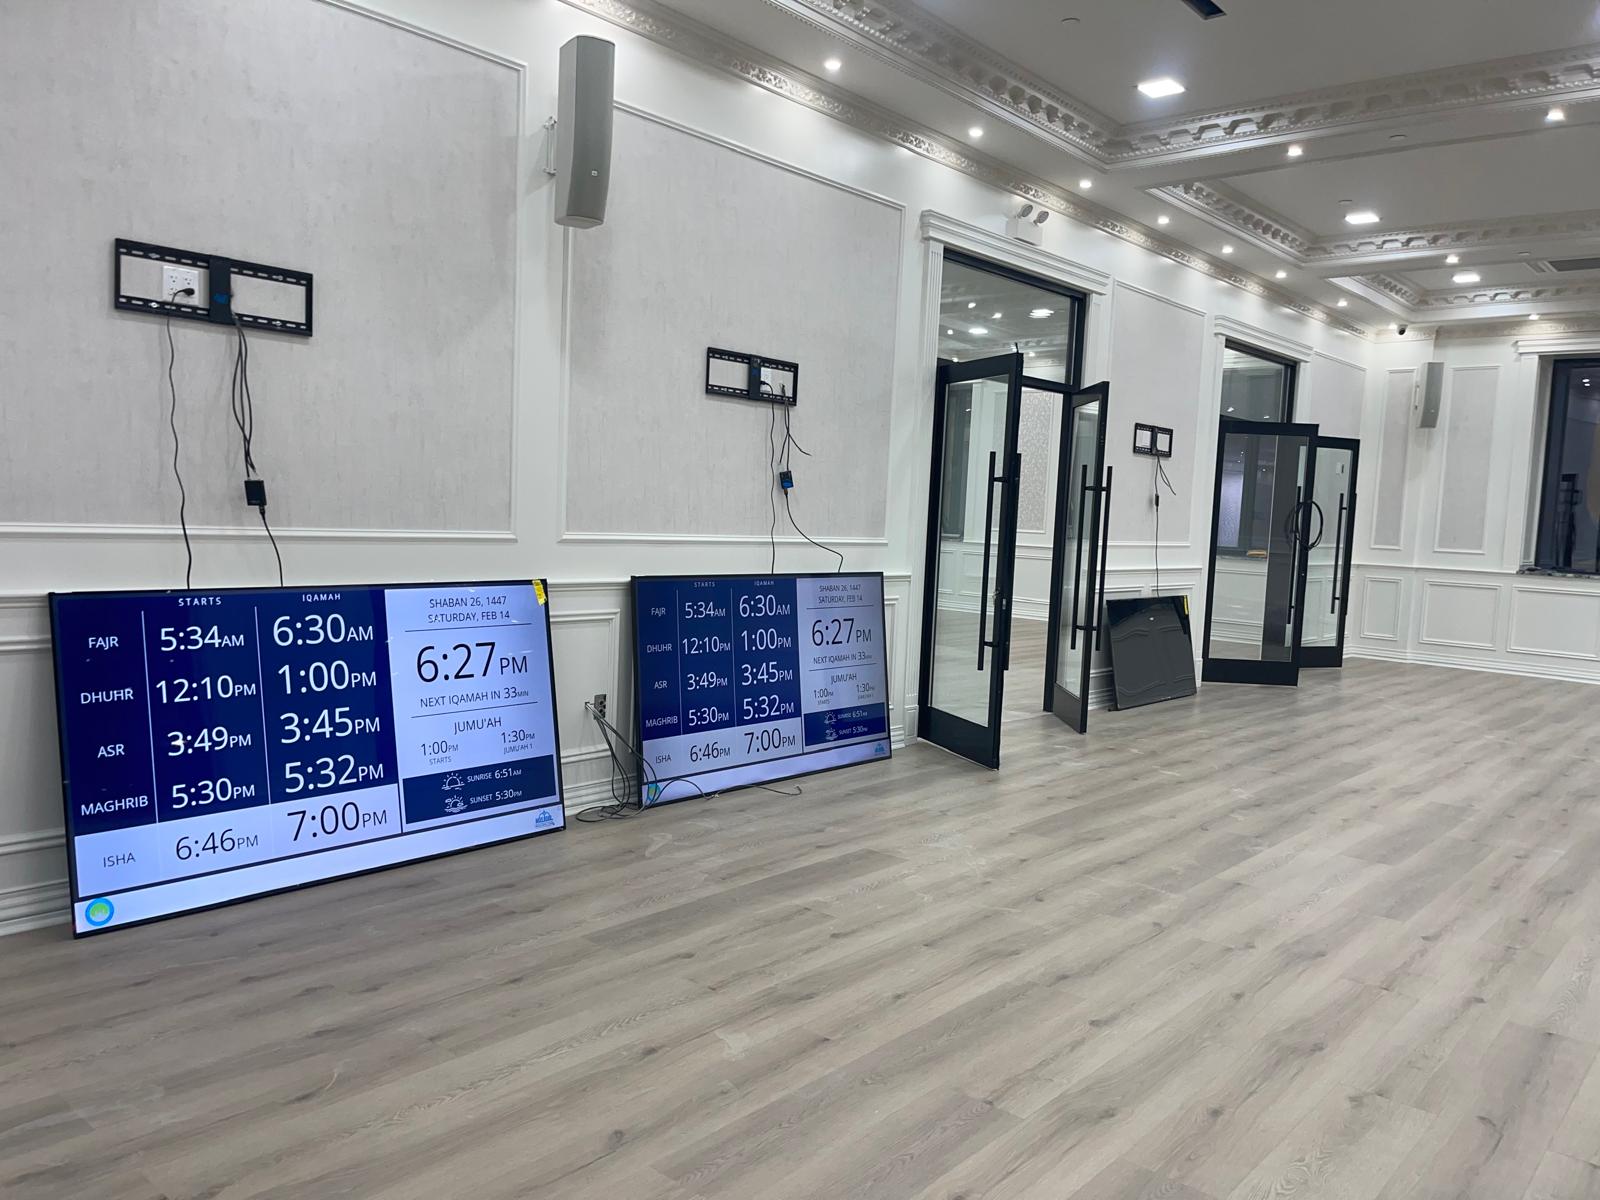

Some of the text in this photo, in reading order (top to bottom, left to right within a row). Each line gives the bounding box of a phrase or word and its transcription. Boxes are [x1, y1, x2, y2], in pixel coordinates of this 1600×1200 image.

[819, 584, 840, 592] SHABAN
[849, 583, 862, 591] 1447
[178, 596, 222, 606] STARTS
[302, 593, 341, 602] IQAMAH
[429, 596, 507, 608] SHABAN 26, 1447
[846, 594, 856, 602] FEB
[651, 594, 791, 619] FAJR 5:34AM 6:30AM
[428, 610, 510, 623] SATURDAY, FEB 14
[88, 613, 374, 651] FAJR 5:34AM 6:30AM
[646, 628, 792, 655] DHUHR 12:10PM 1:00PM
[813, 655, 828, 664] NEXT
[828, 654, 849, 664] IQAMAH
[80, 660, 377, 704] DHUHR 12:10PM 1:00PM
[654, 661, 793, 691] ASR 3:49PM 3:45PM
[420, 696, 449, 708] NEXT
[449, 692, 489, 705] IQAMAH
[491, 691, 501, 701] IN
[645, 694, 795, 728] MAGHRIB 5:30PM 5:32PM
[97, 706, 380, 758] ASR 3:49PM 3:45PM
[454, 717, 502, 735] JUMU'AH
[655, 727, 796, 764] ISHA 6:46PM 7:00PM
[429, 756, 452, 765] STARTS
[81, 754, 384, 816] MAGHRIB 5:30PM 5:32PM
[467, 772, 492, 783] SUNRISE
[469, 794, 493, 804] SUNSET
[103, 801, 387, 868] ISHA 6:46PM 7:00PM
